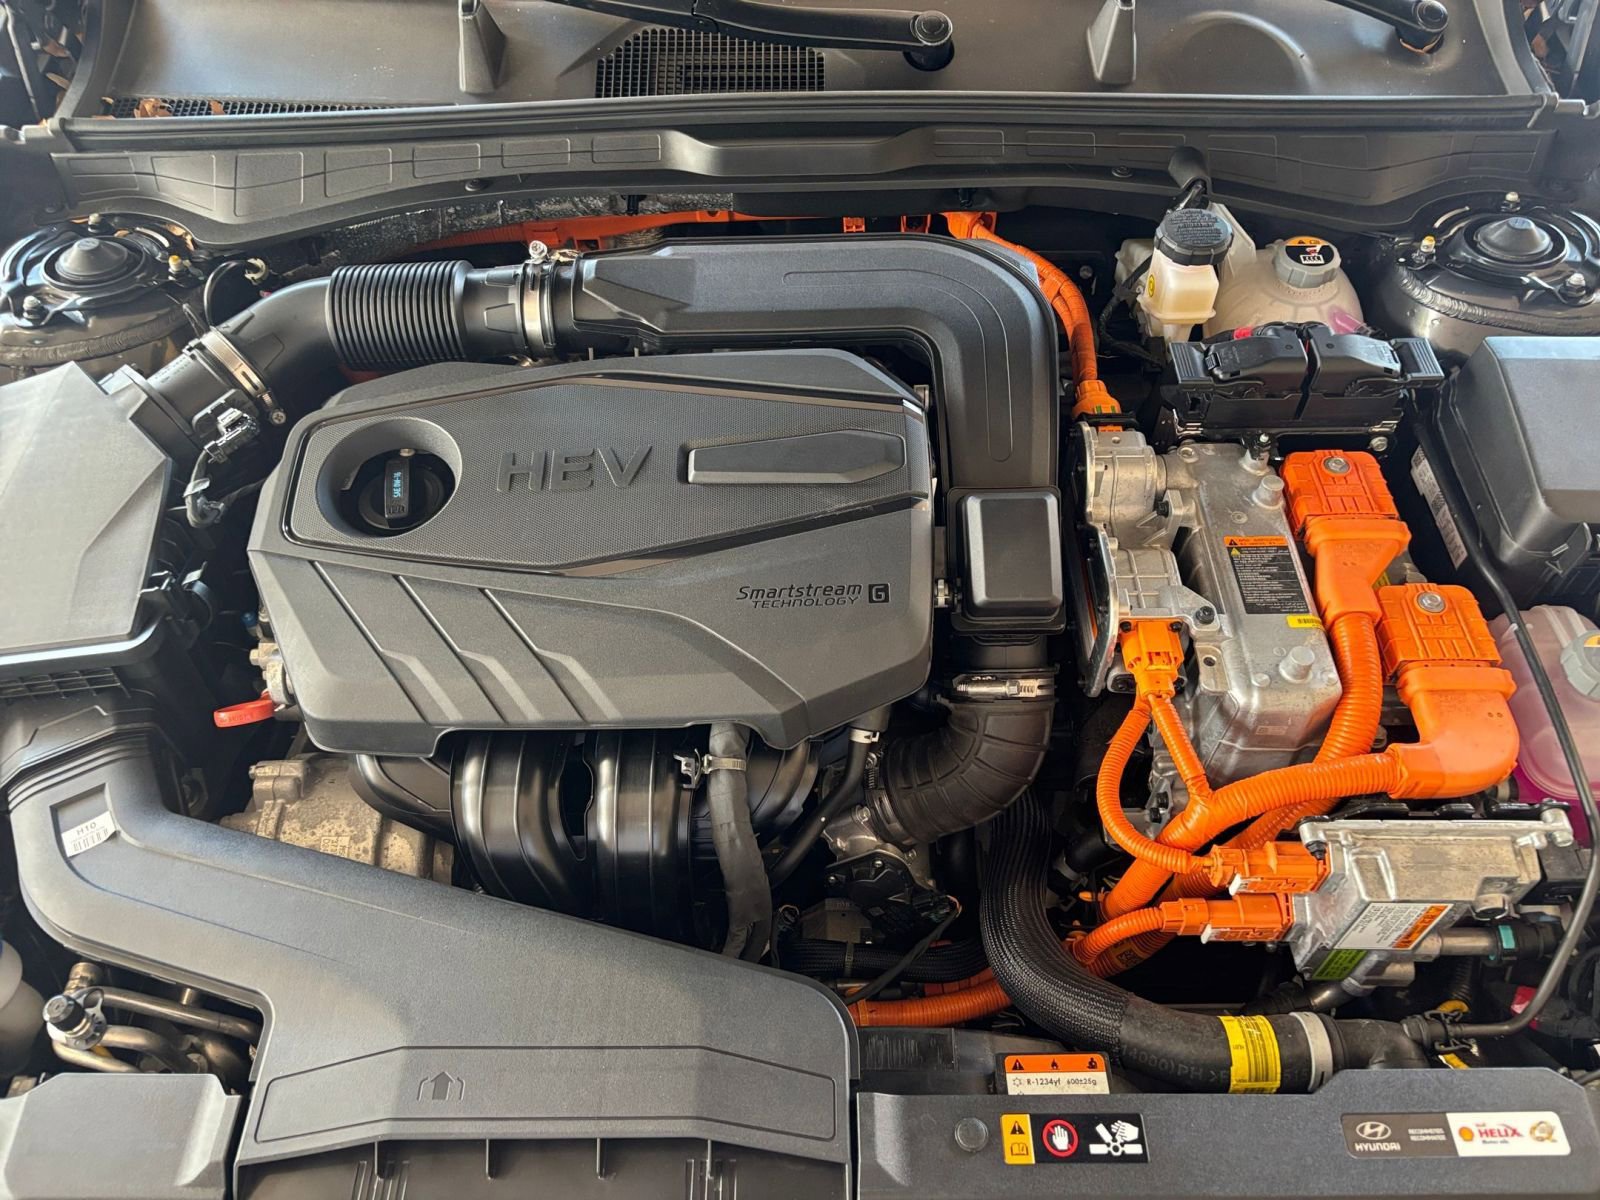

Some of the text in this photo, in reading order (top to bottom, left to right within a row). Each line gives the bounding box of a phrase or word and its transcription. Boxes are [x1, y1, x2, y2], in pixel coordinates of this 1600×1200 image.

[497, 445, 652, 491] HEV
[736, 583, 887, 602] Smartstream G
[751, 596, 859, 609] TECHNOLOGY
[1026, 1078, 1061, 1087] R-1234yf
[1477, 1124, 1522, 1138] HELIX
[1354, 1142, 1401, 1152] HYUNDAI
